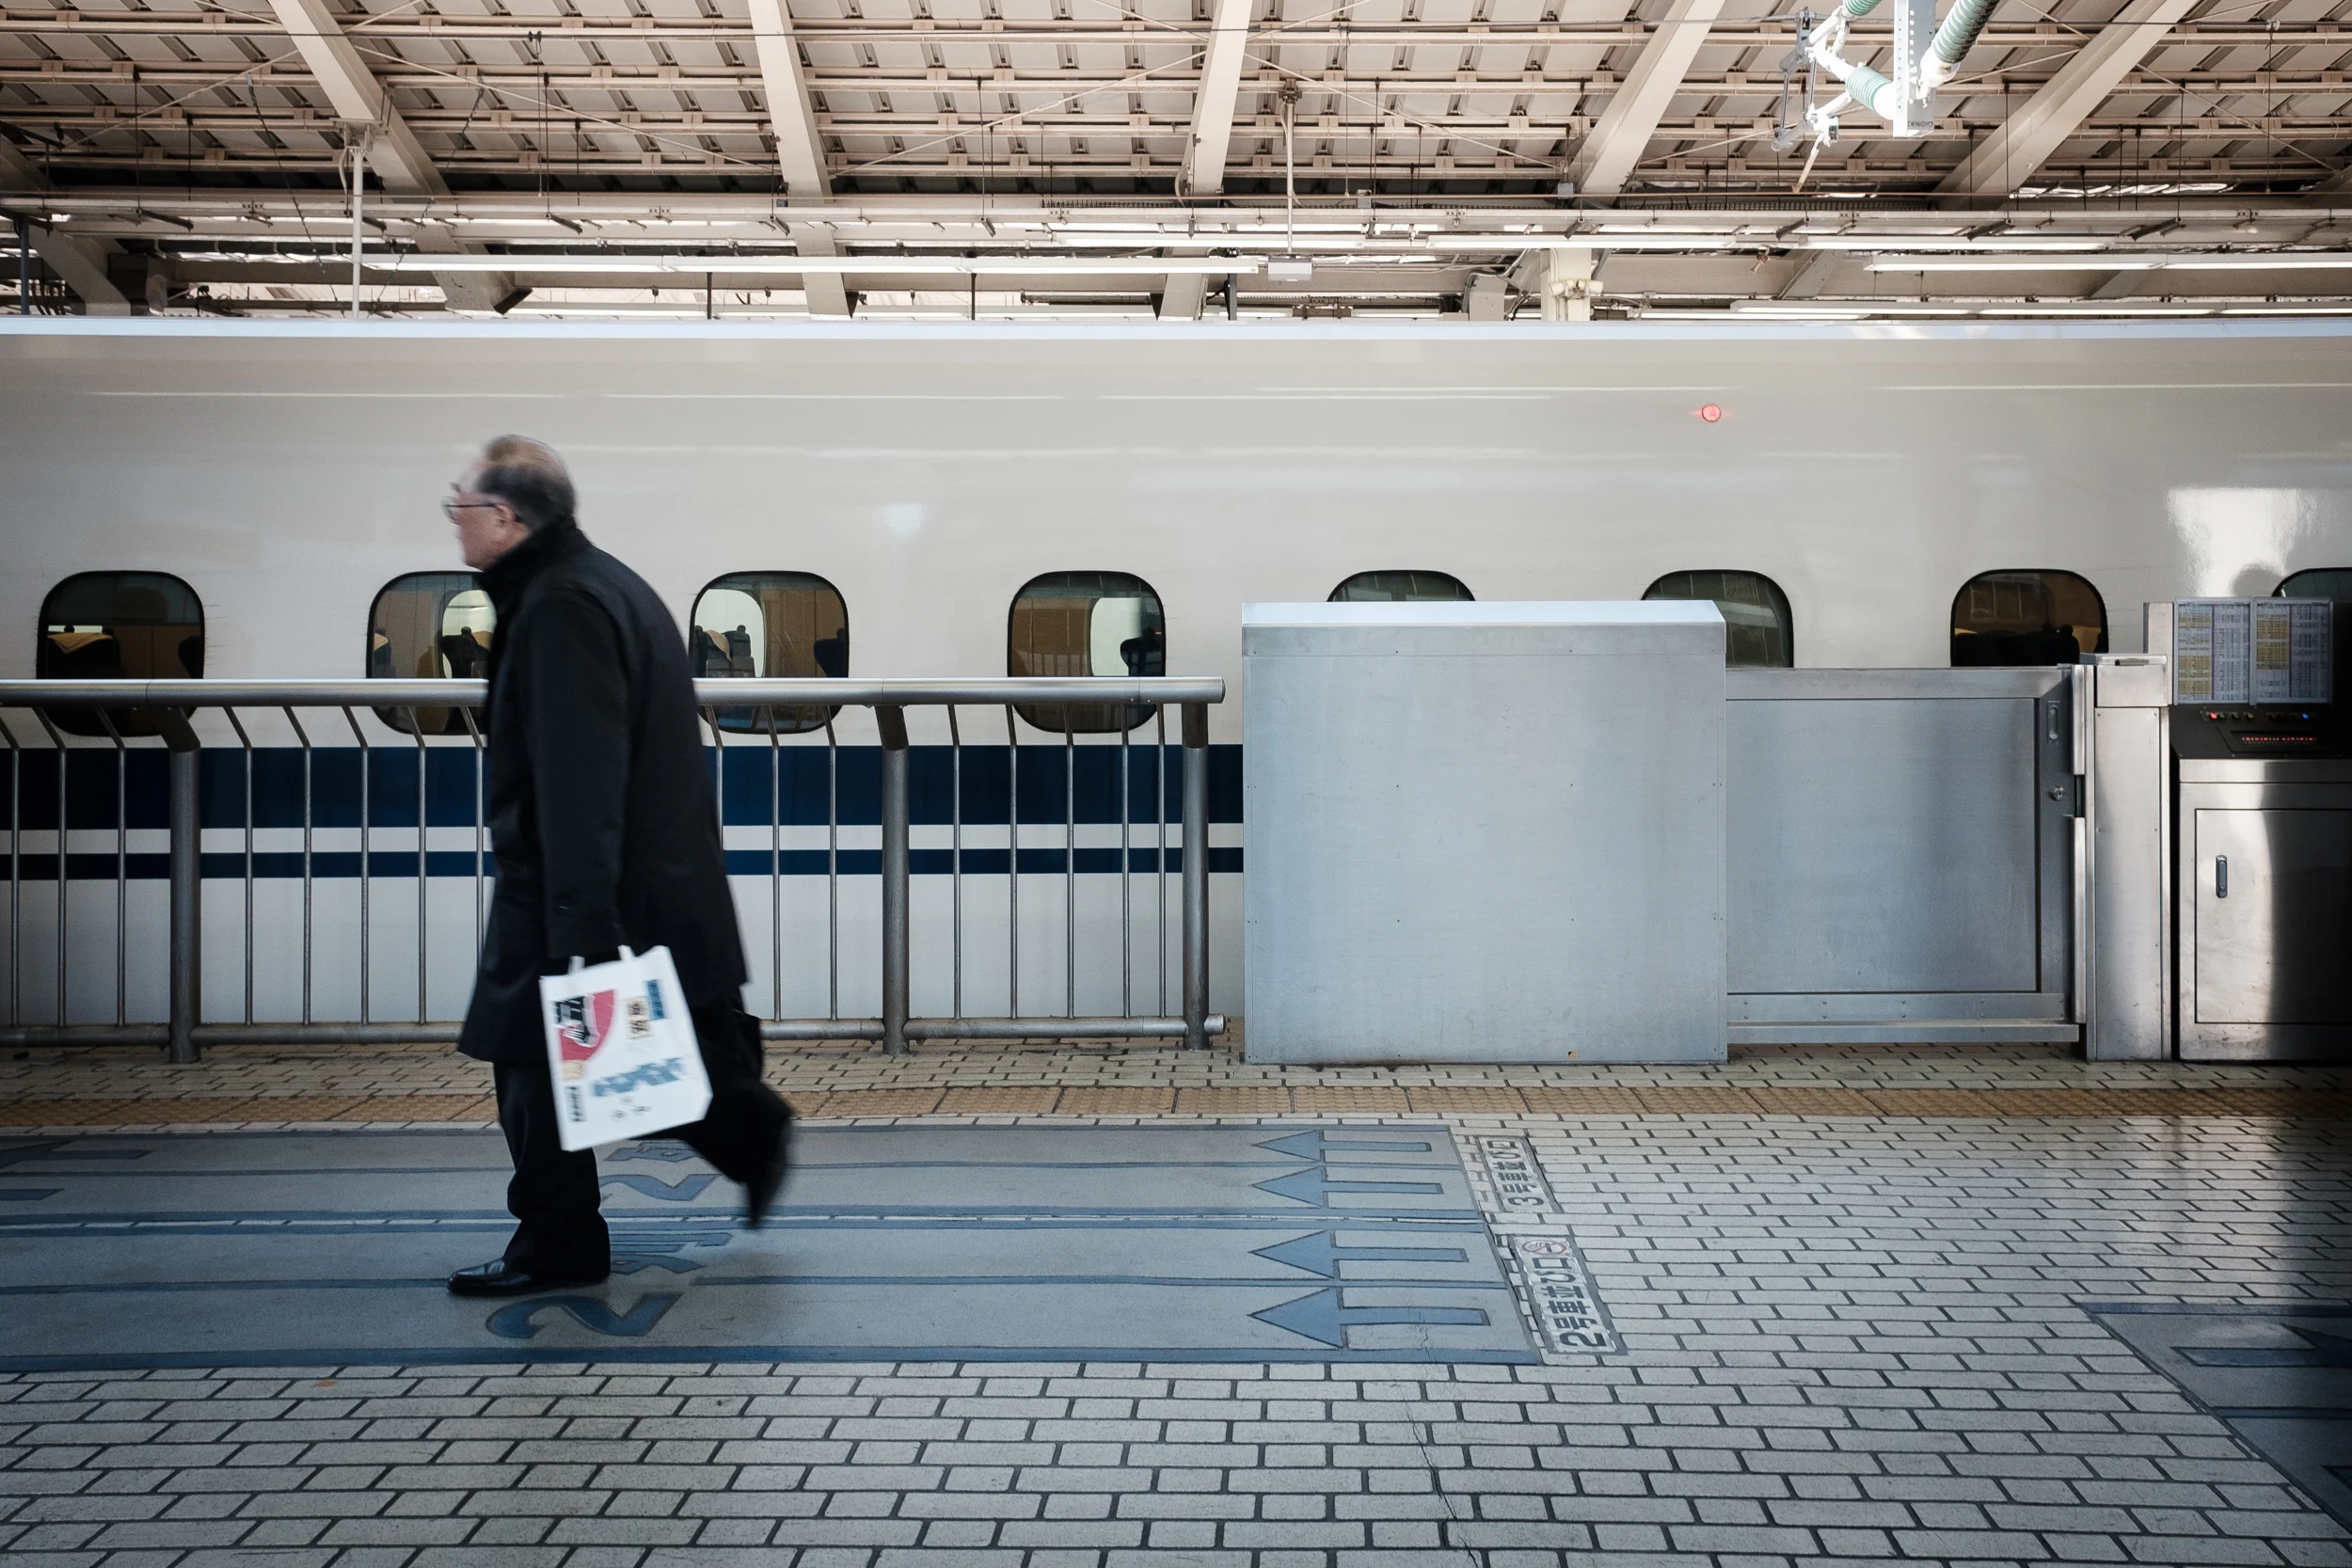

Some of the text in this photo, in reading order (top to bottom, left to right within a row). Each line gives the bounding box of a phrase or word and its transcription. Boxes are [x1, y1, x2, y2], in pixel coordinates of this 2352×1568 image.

[1486, 1140, 1544, 1206] 3号車並び口
[1533, 1257, 1607, 1347] 2号車並び口
